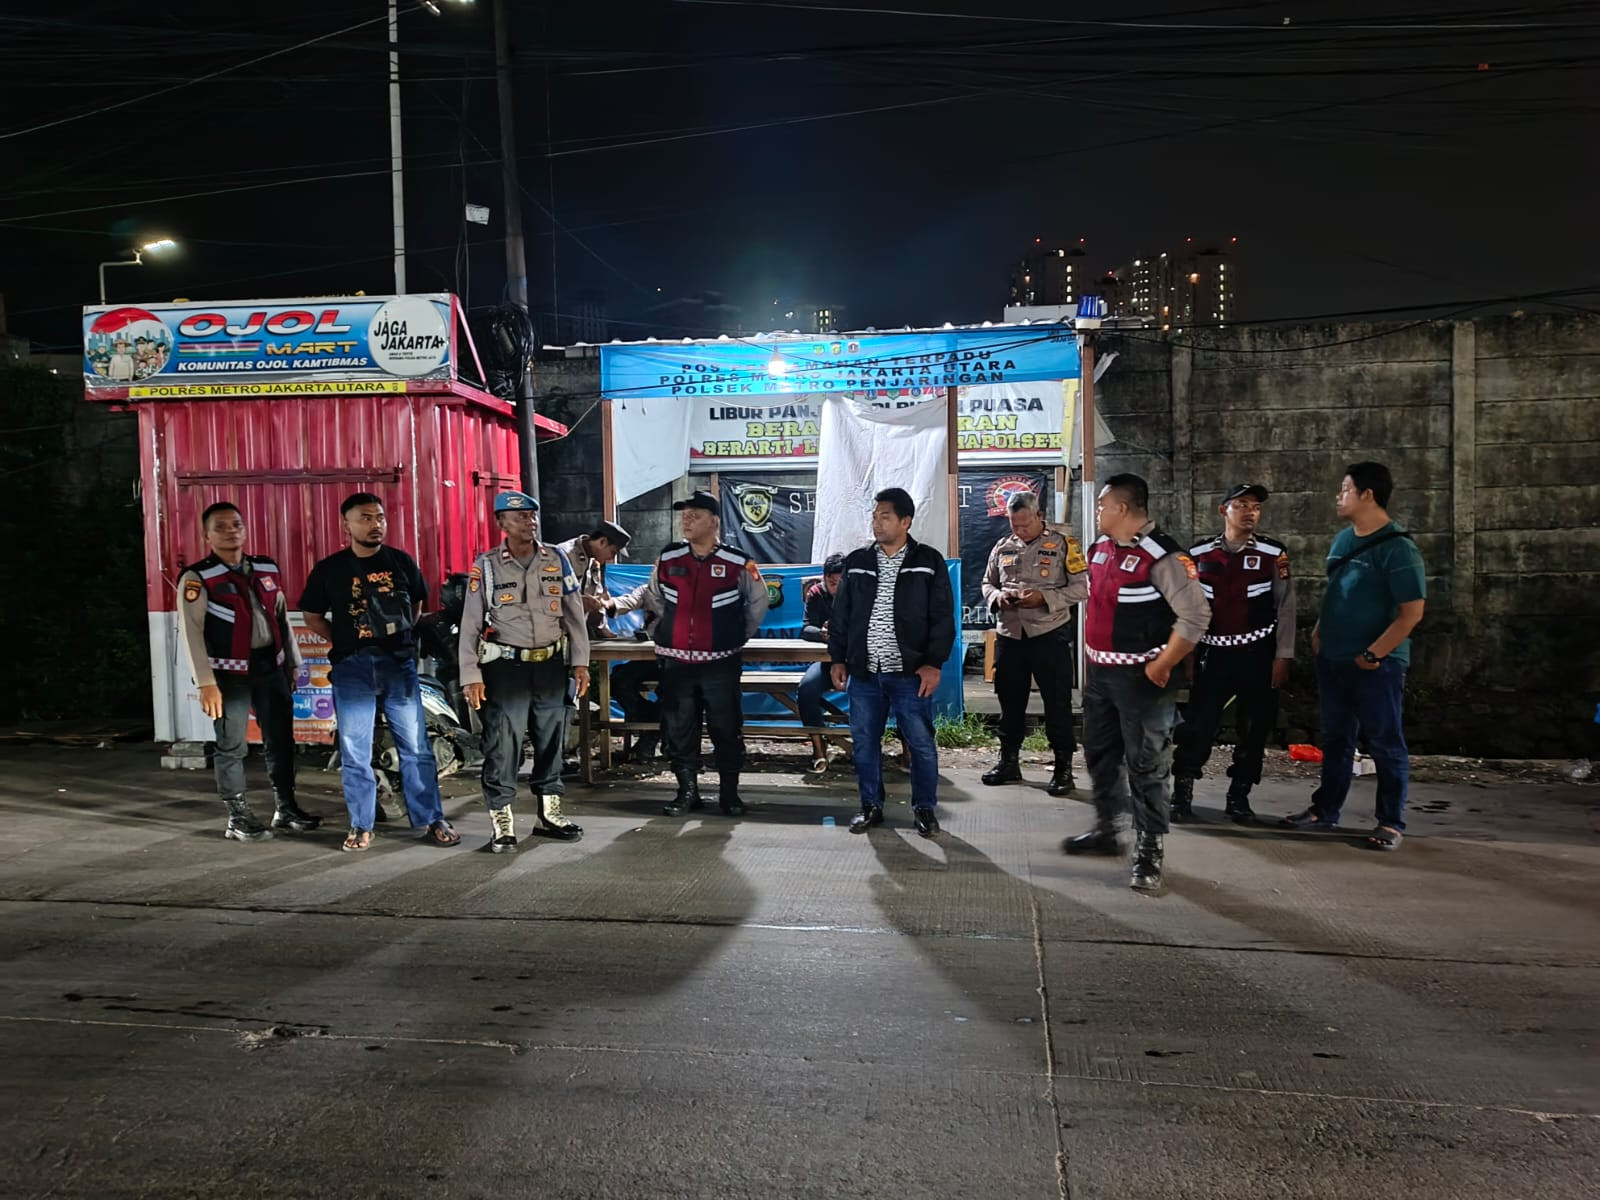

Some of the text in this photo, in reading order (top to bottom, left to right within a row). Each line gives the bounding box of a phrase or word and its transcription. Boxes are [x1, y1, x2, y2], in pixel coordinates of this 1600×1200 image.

[179, 309, 351, 337] OJOL
[373, 320, 408, 337] JAGA
[266, 341, 358, 356] MART
[177, 357, 368, 371] KOMUNITAS OJOL KAMTIBMAS
[682, 350, 991, 373] POS PENAMANAN TERPADU
[660, 359, 1016, 385] POLRES METRO JAKARTA UTARA
[150, 382, 386, 396] POLRES METRO JAKARTA UTARA
[671, 371, 1004, 395] POLSEK METRO PENJARINGAN
[709, 405, 822, 420] LIBUR PANJ
[970, 397, 1044, 413] PUASA
[746, 420, 820, 438] BERA
[957, 415, 1018, 432] RAN
[703, 439, 793, 456] BERARTI
[789, 492, 818, 514] SE
